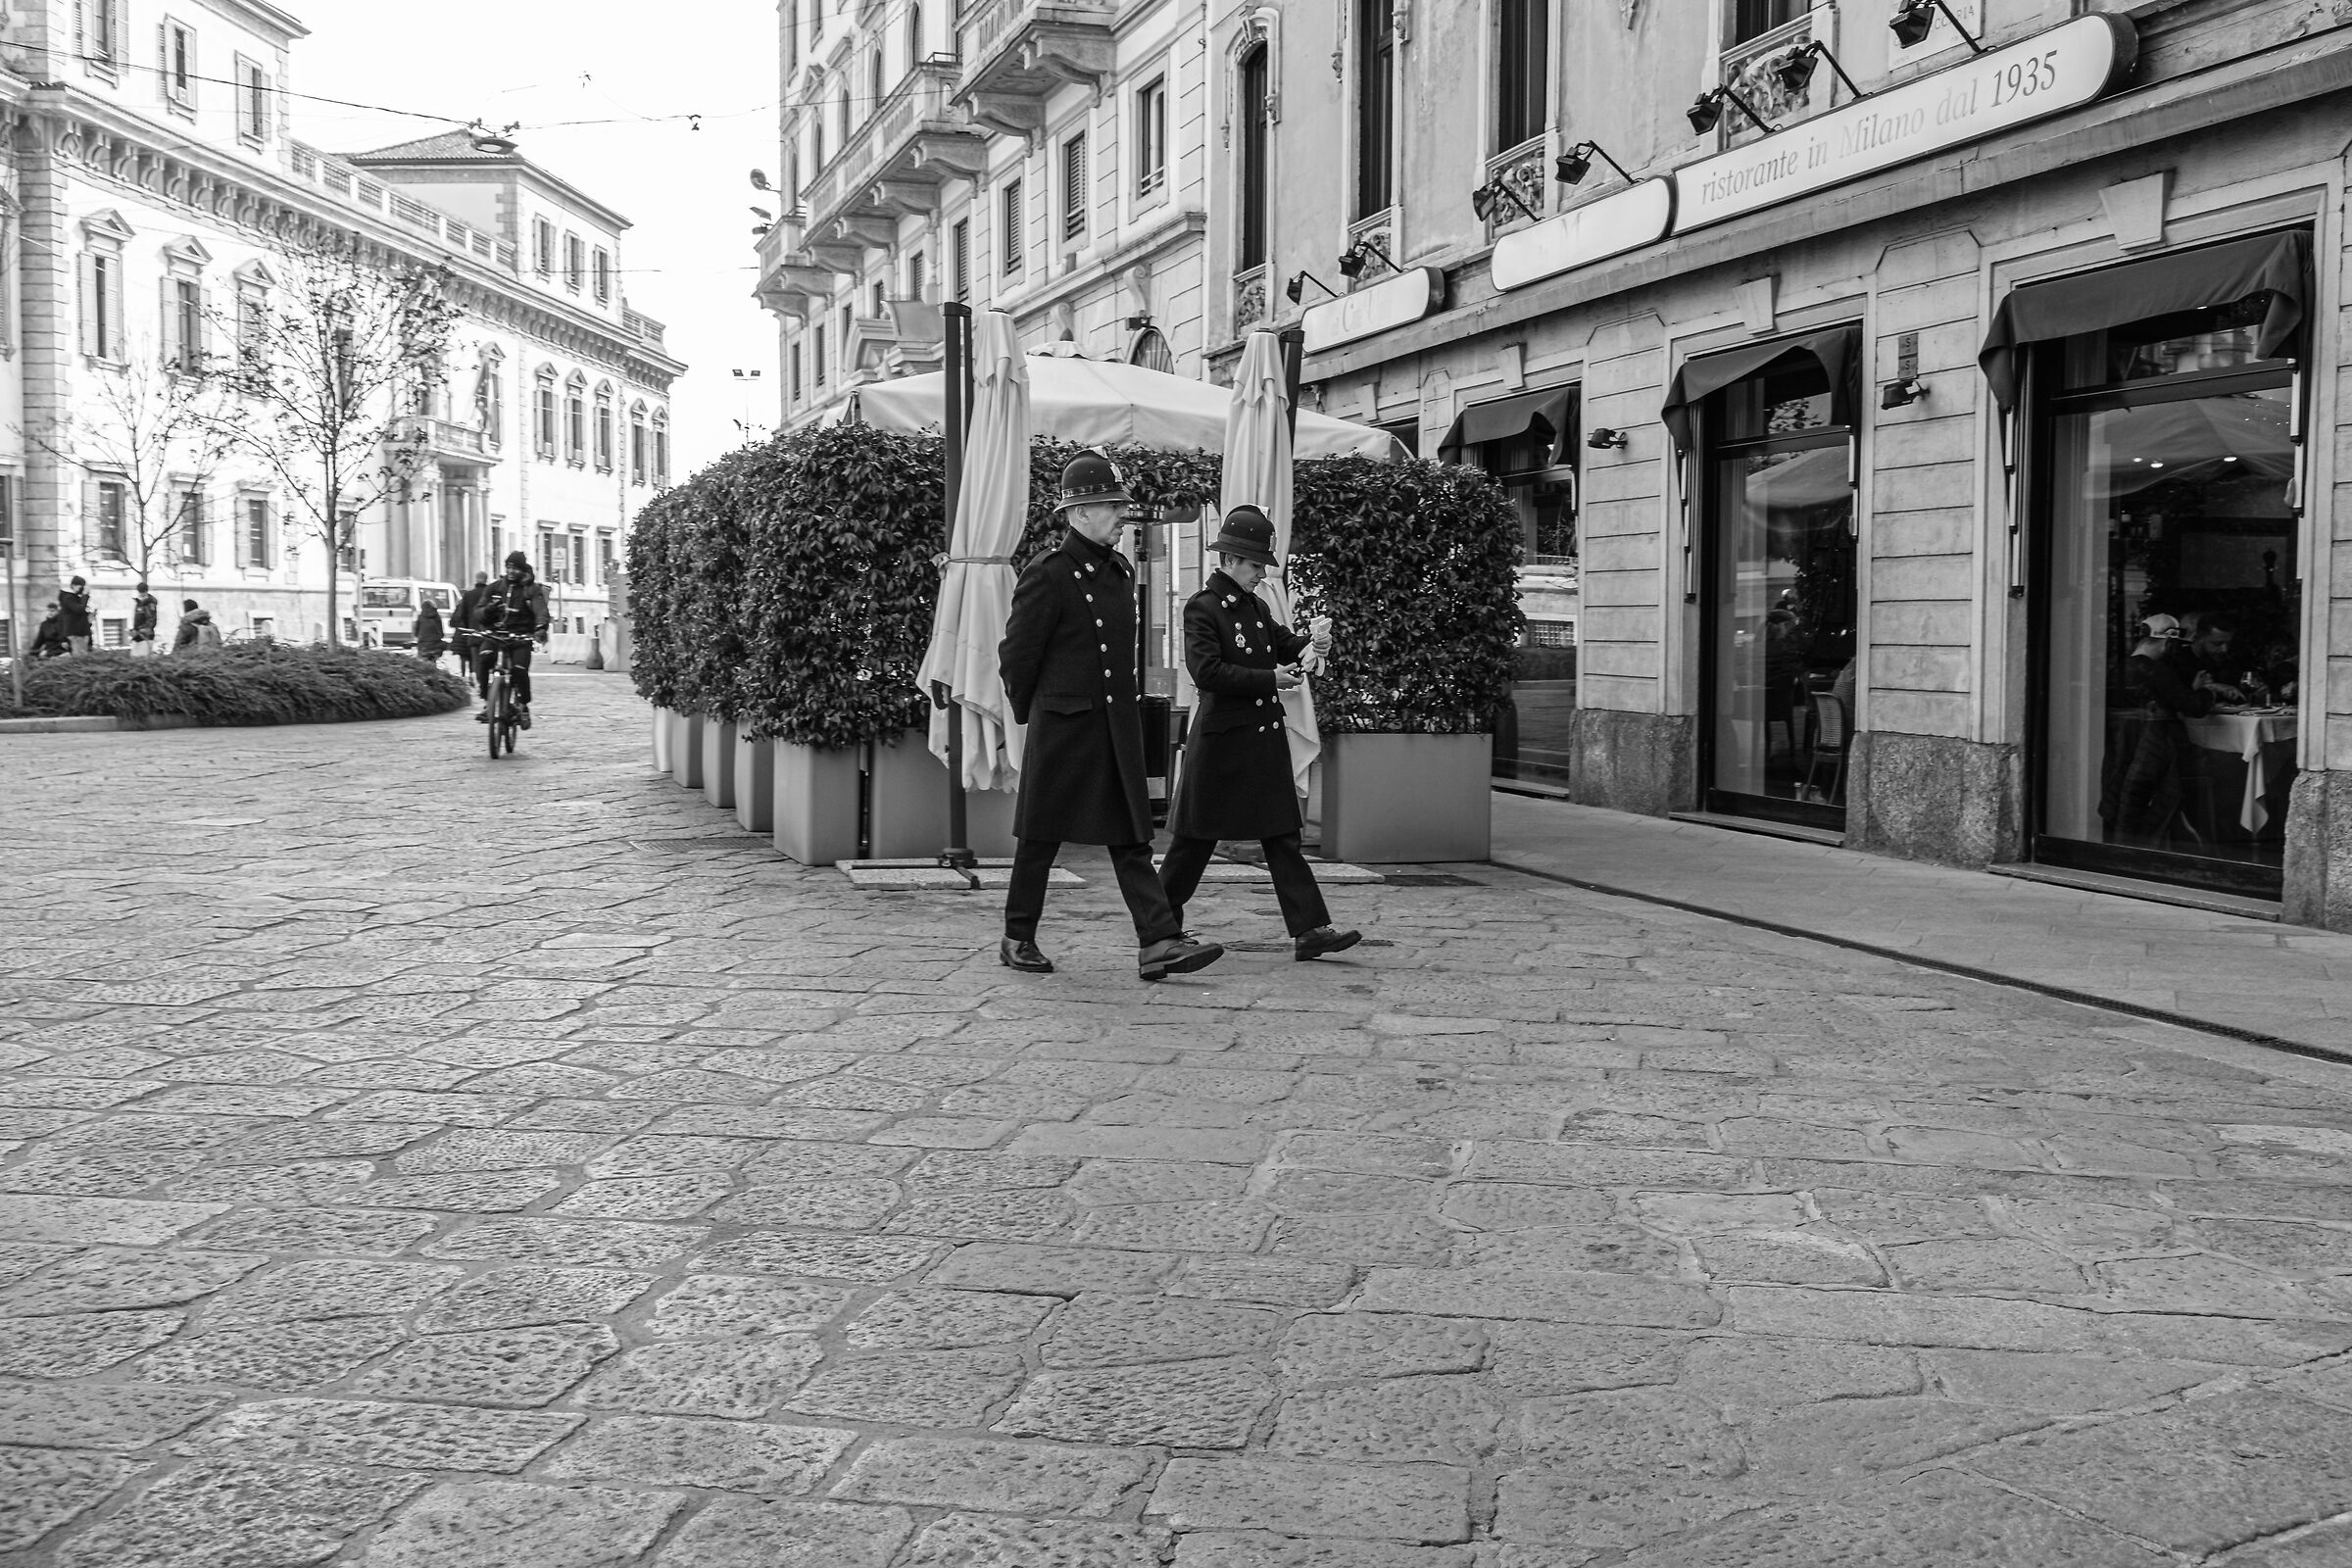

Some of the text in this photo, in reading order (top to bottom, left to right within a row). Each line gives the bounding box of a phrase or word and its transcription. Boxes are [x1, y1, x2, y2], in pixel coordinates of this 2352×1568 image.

[1701, 48, 2058, 205] ristorante in Milano dal 1935
